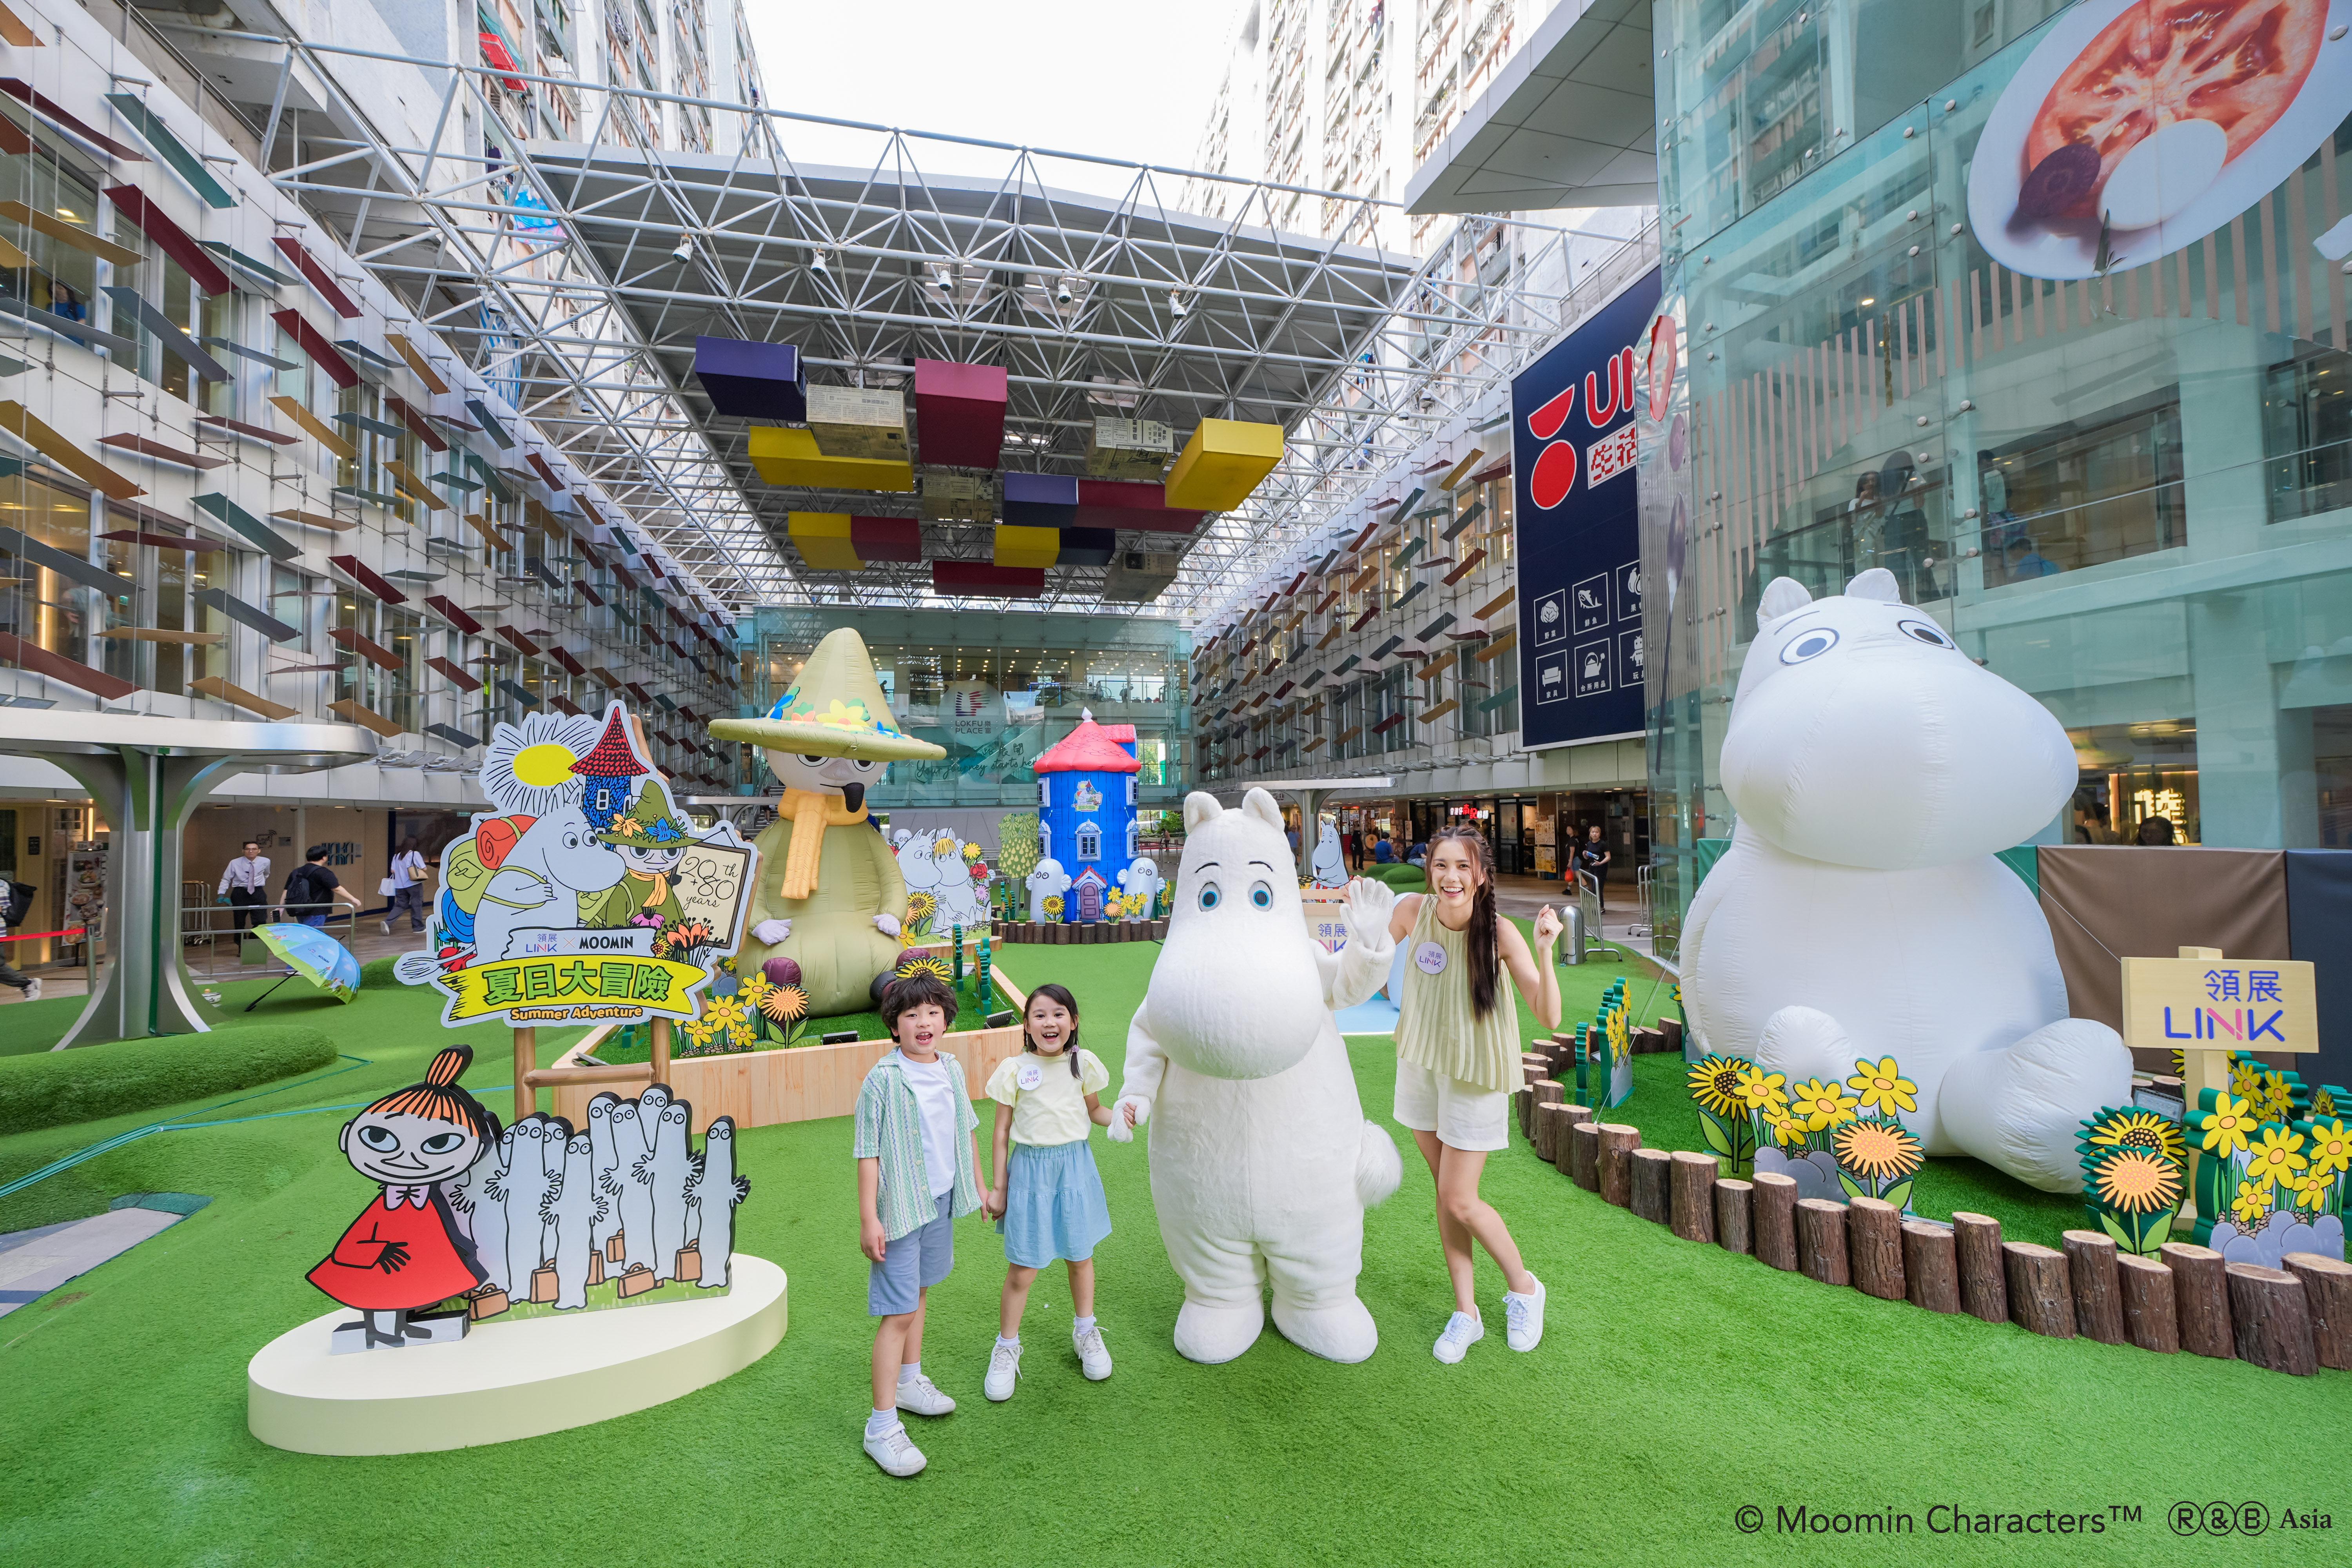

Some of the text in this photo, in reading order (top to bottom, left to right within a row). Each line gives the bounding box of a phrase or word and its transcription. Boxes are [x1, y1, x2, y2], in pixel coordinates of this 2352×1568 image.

[1544, 630, 1556, 640] 野菜
[1581, 680, 1606, 692] 台所用品
[1546, 690, 1558, 699] 家具
[915, 760, 942, 780] Your
[943, 764, 987, 779] journey
[991, 757, 1018, 770] starts
[683, 897, 720, 910] years
[1318, 924, 1348, 937] 領展
[526, 944, 557, 953] LINK
[579, 936, 633, 949] MOOMIN
[537, 934, 557, 942] 領展
[1419, 955, 1441, 967] LINK
[1428, 951, 1442, 960] 領展
[482, 960, 673, 1006] 夏日大冒險
[2204, 970, 2283, 1002] 領展
[510, 1005, 643, 1021] Summer Adventure
[2164, 1006, 2285, 1042] LINK
[1021, 1076, 1039, 1084] LINK
